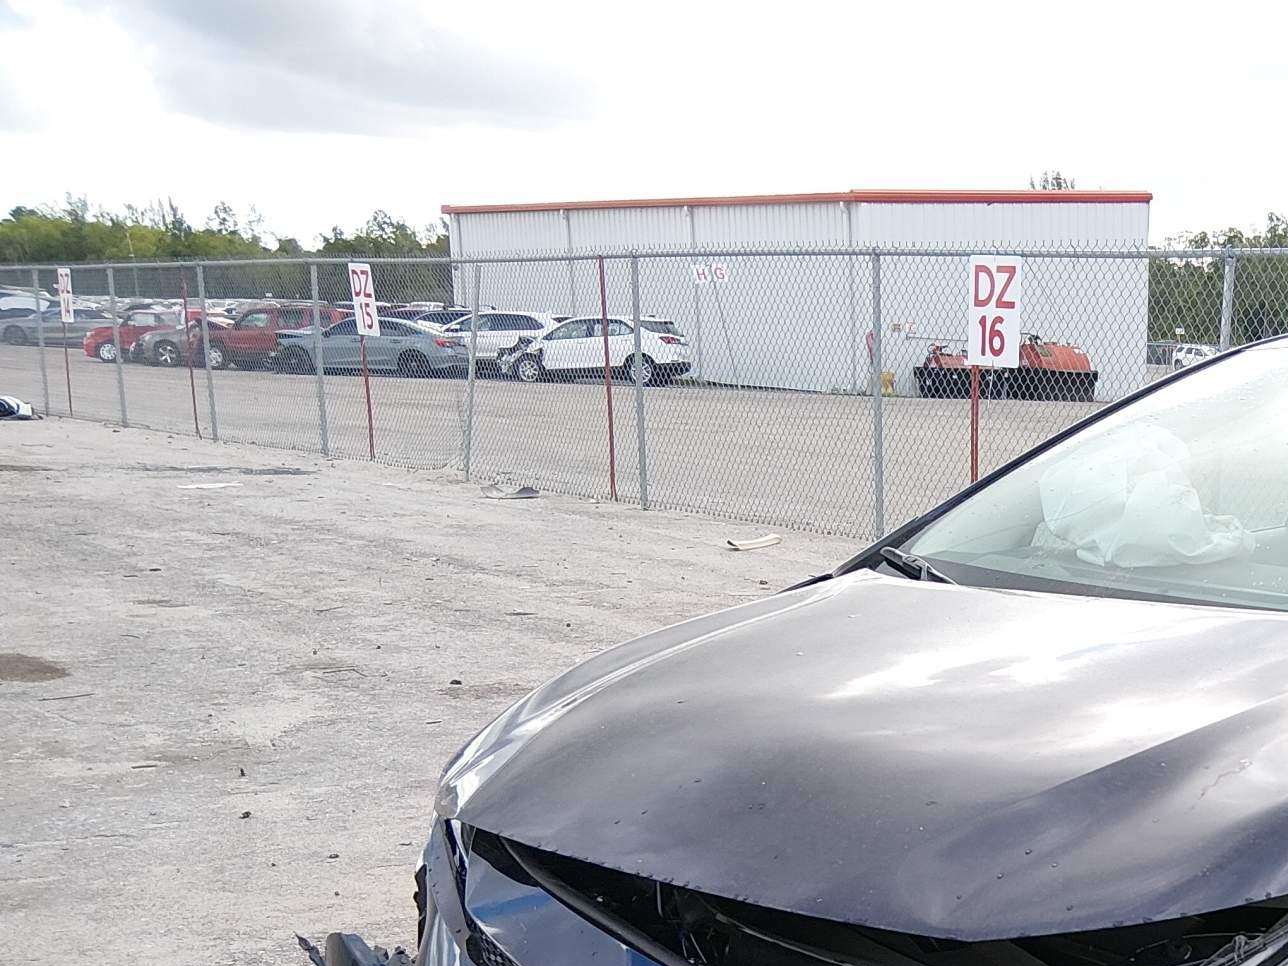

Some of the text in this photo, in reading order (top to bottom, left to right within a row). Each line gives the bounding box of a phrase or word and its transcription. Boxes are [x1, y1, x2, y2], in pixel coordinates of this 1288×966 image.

[351, 269, 373, 298] DZ
[714, 267, 725, 280] G
[973, 264, 1017, 310] DZ
[359, 302, 374, 330] 15
[978, 314, 1006, 358] 16
